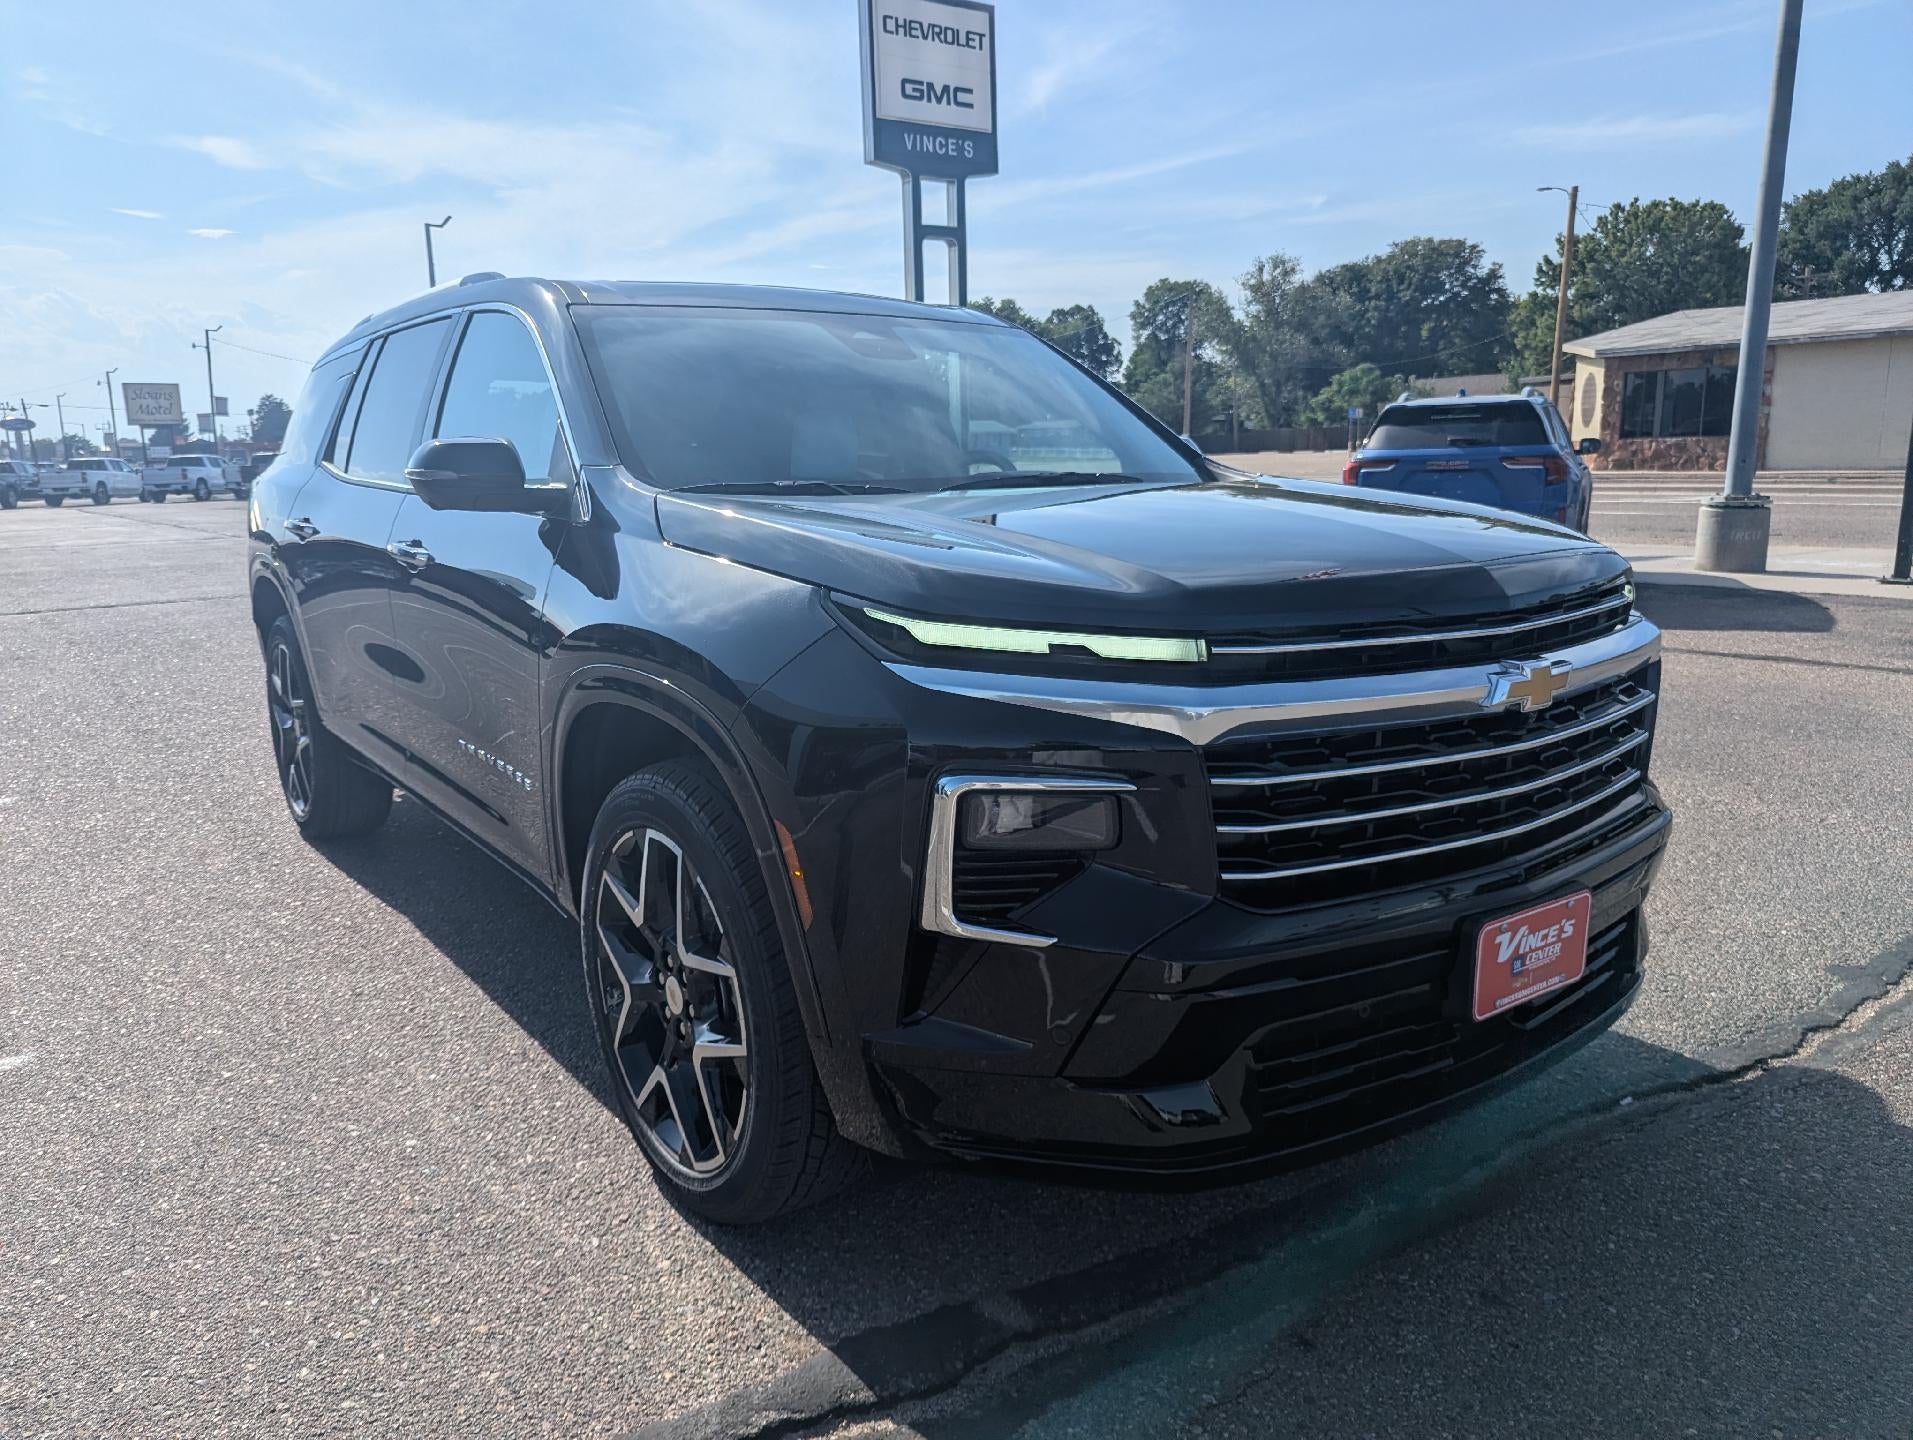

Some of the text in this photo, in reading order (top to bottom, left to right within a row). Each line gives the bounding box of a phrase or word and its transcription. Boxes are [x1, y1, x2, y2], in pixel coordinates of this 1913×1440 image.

[882, 14, 986, 51] CHEVROLET
[900, 77, 974, 110] GMC
[904, 132, 974, 158] VINCE'S
[136, 402, 173, 416] Motel
[1526, 942, 1562, 965] CENTER
